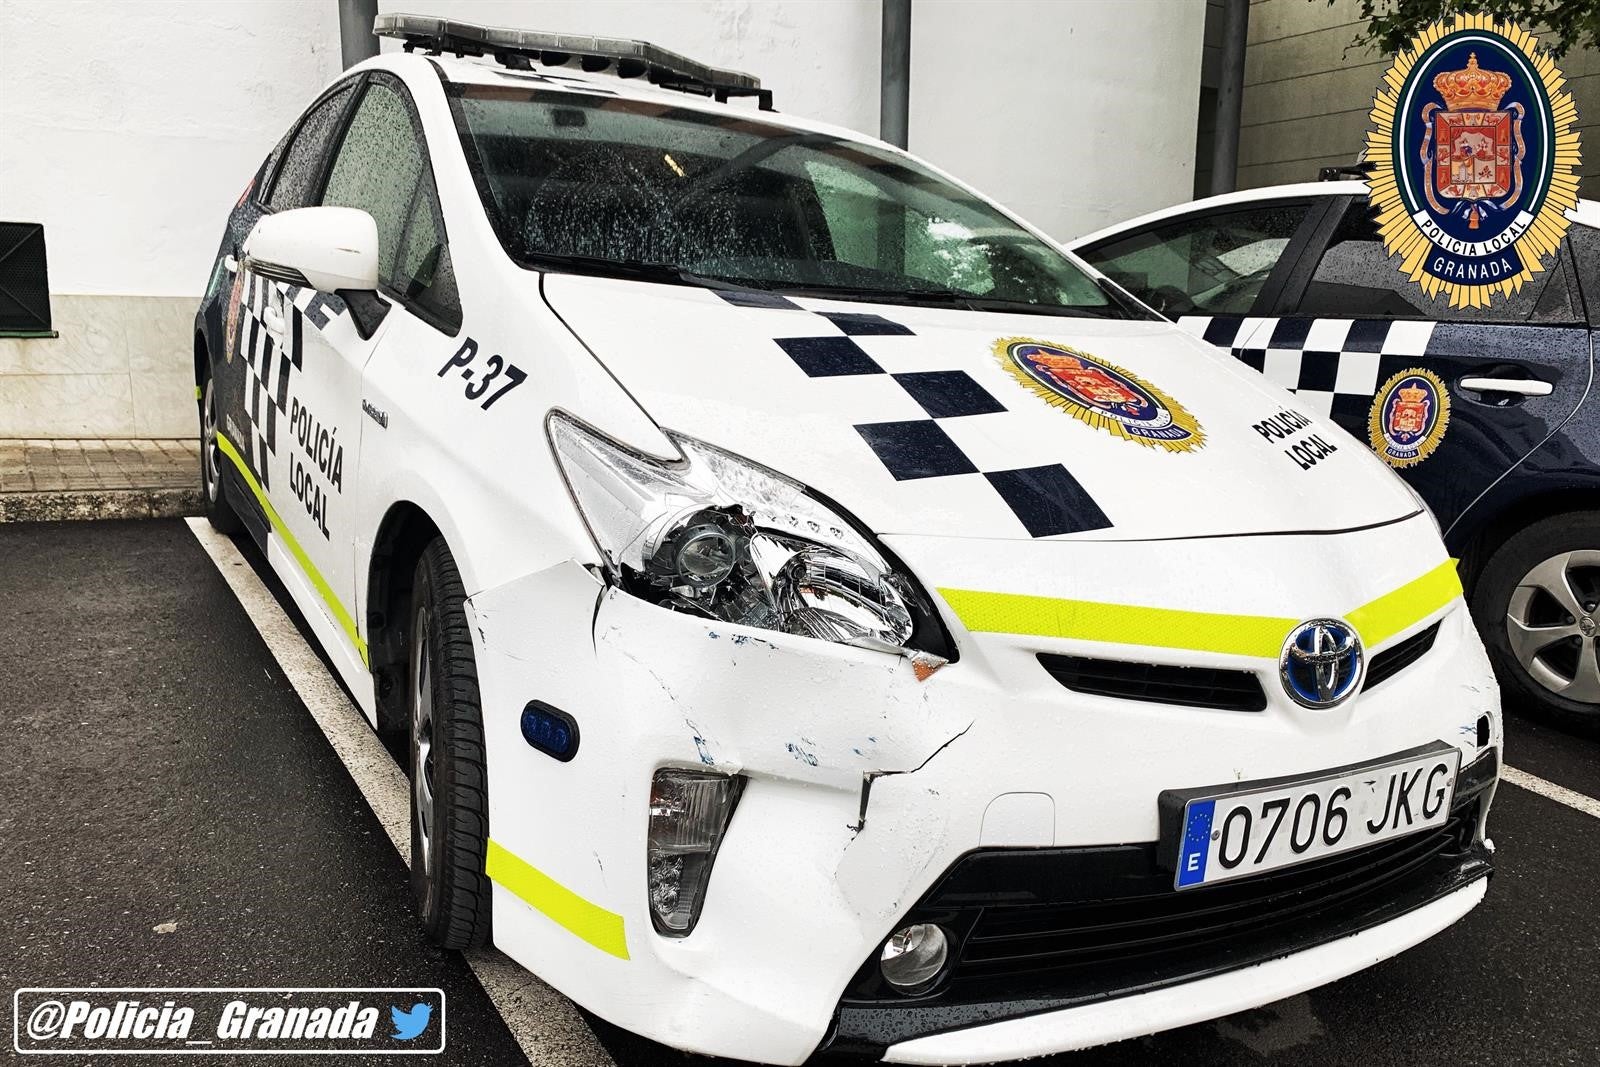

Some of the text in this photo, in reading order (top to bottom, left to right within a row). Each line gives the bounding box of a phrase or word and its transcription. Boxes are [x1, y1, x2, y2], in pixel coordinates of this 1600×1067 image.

[290, 396, 343, 494] POLICÍA
[1131, 427, 1187, 439] GRANADA
[1284, 434, 1338, 471] LOCAL
[290, 452, 330, 541] LOCAL
[1218, 763, 1449, 870] 0706 JKG
[1187, 852, 1201, 872] E
